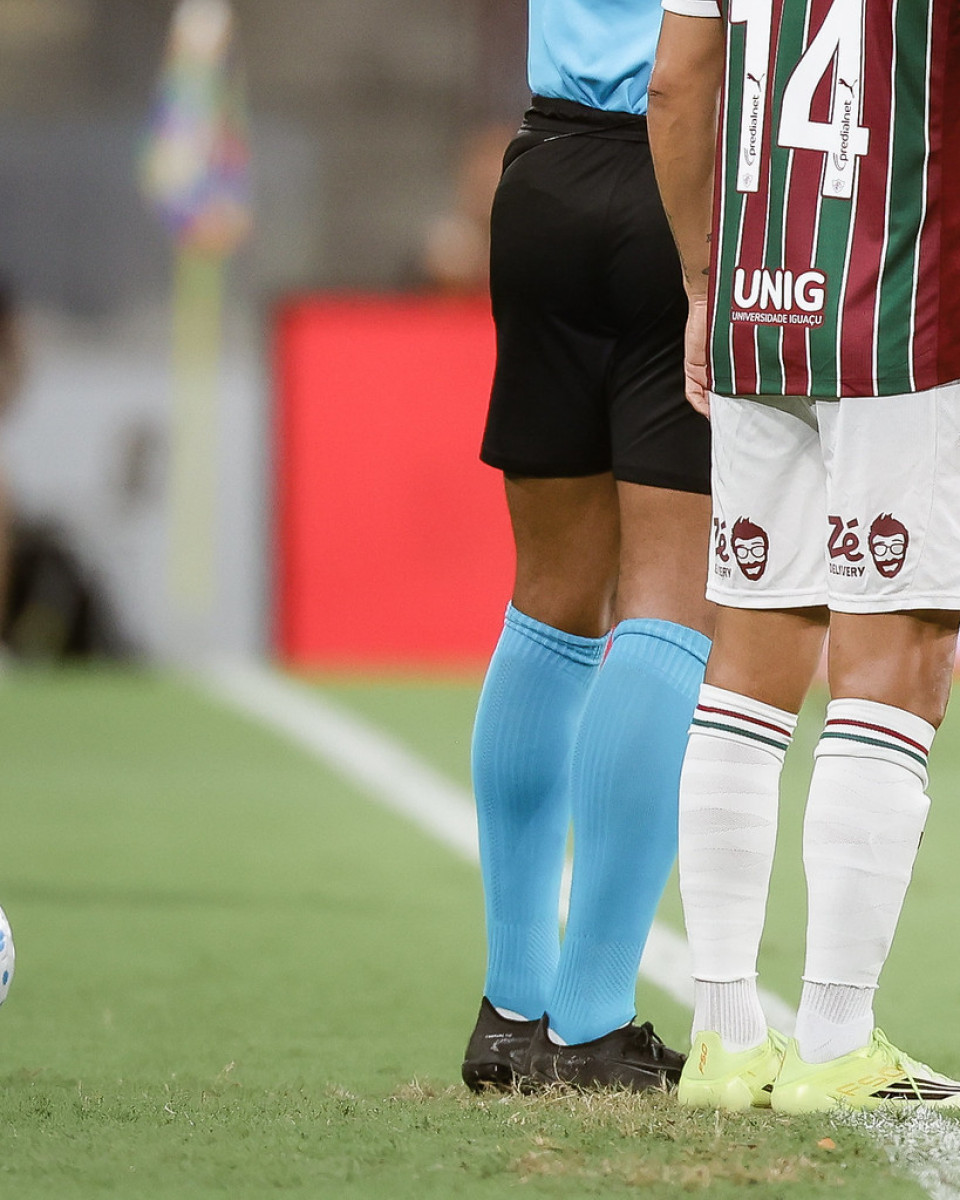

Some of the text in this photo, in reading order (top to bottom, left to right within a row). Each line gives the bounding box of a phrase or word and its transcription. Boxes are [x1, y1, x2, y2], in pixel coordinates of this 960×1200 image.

[748, 94, 760, 156] predialnet
[839, 100, 852, 162] predialnet
[734, 268, 826, 312] UNIG
[731, 311, 823, 326] UNIVERSIDADE IGUAÇU
[828, 515, 865, 562] Zé
[829, 563, 866, 577] DELIVERY
